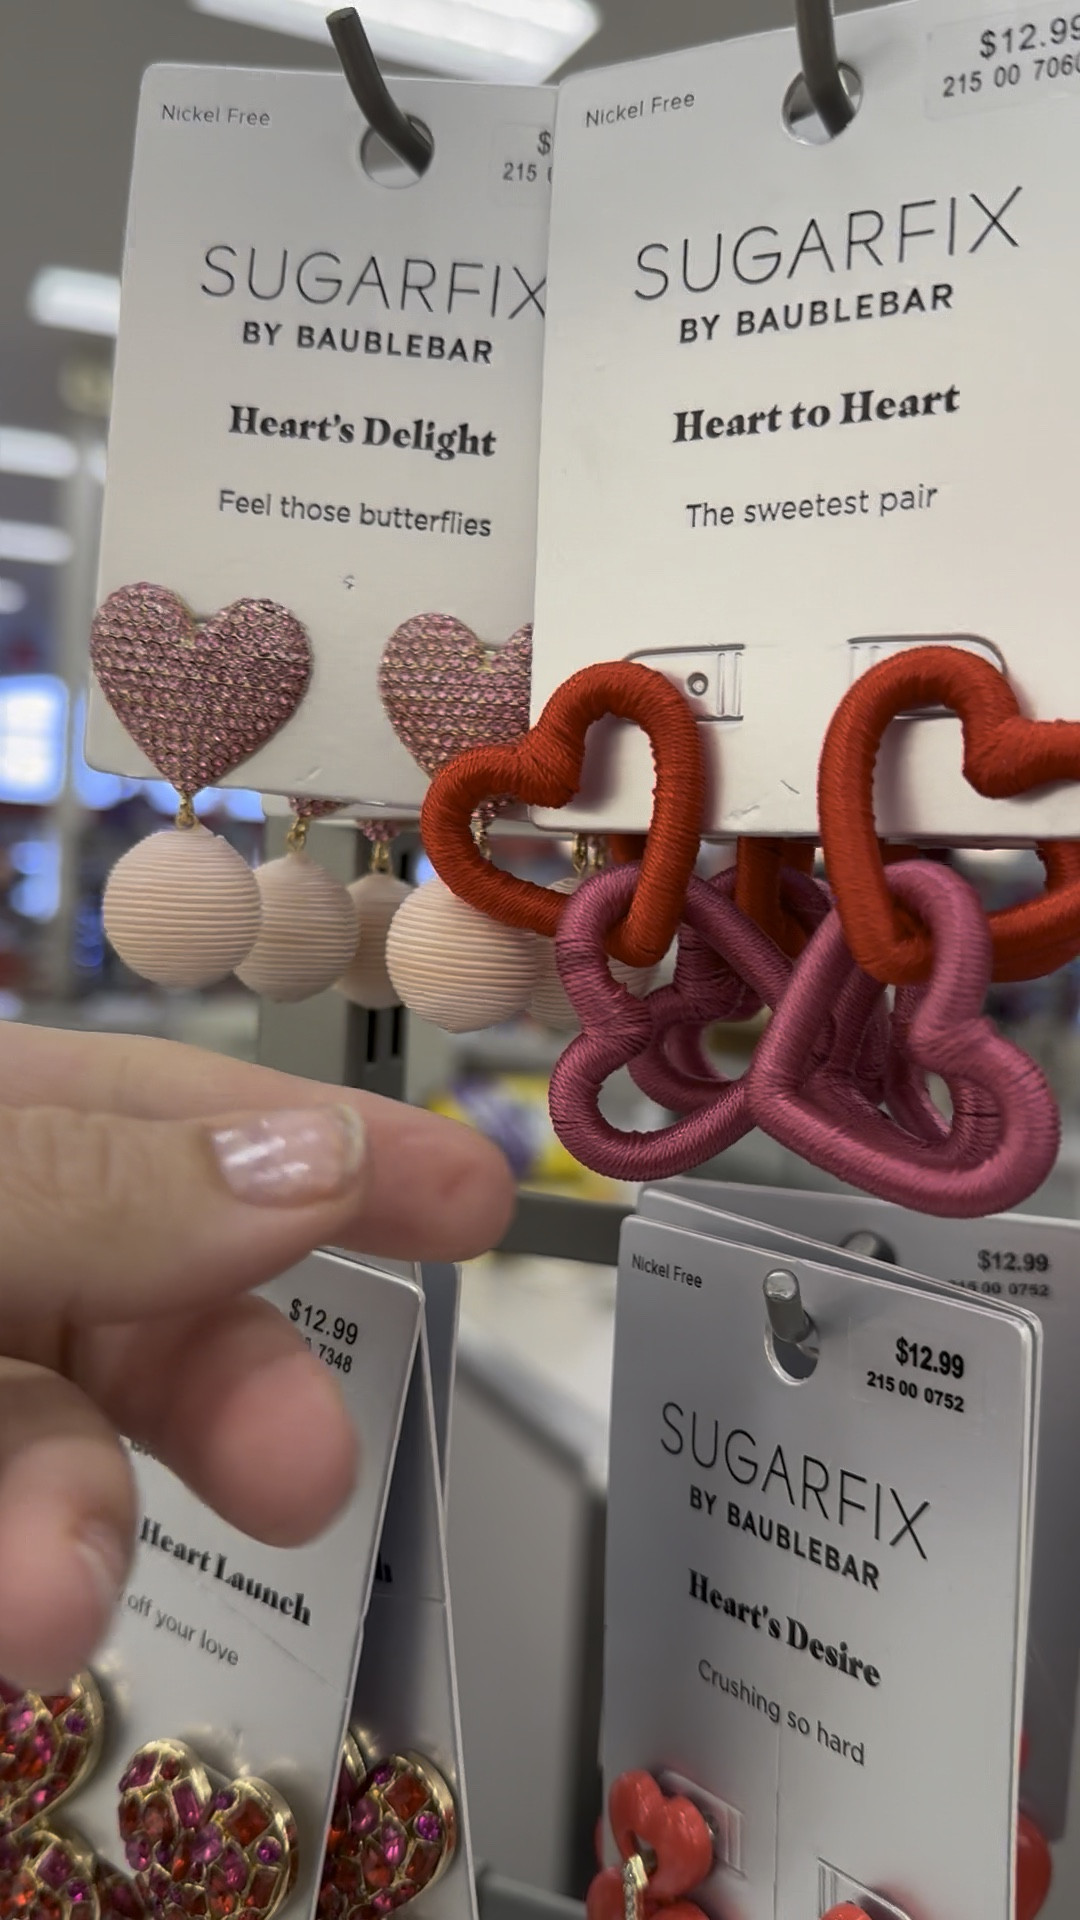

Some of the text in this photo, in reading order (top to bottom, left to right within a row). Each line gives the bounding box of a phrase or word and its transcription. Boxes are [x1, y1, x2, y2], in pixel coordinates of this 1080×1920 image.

[980, 14, 1080, 60] $12.99
[943, 70, 982, 97] 215
[994, 63, 1020, 88] 00
[161, 104, 271, 126] Nickel Free
[585, 91, 696, 128] Nickel Free
[503, 162, 537, 182] 215
[634, 186, 1023, 301] SUGARFIX
[200, 245, 546, 320] SUGARFIX
[679, 283, 954, 344] BY BAUBLEBAR
[243, 321, 493, 364] BY BAUBLEBAR
[672, 384, 961, 443] Heart to Heart
[362, 417, 497, 460] Delight
[219, 490, 492, 537] Feel those butterflies
[687, 483, 938, 528] The sweetest pair
[631, 1253, 702, 1289] Nickel Free
[977, 1248, 1049, 1272] $12.99
[1008, 1282, 1050, 1297] 0752
[289, 1298, 358, 1345] $12.99
[319, 1343, 352, 1373] 7348
[895, 1337, 964, 1379] $12.99
[866, 1371, 964, 1413] 215 00 0752
[660, 1402, 930, 1560] SUGARFIX
[689, 1484, 880, 1590] BY BAUBLEBAR
[139, 1516, 214, 1573] Heart
[213, 1553, 312, 1627] Launch
[127, 1592, 240, 1667] off your love
[786, 1616, 881, 1687] Desire
[697, 1659, 865, 1766] Crushing so hard
